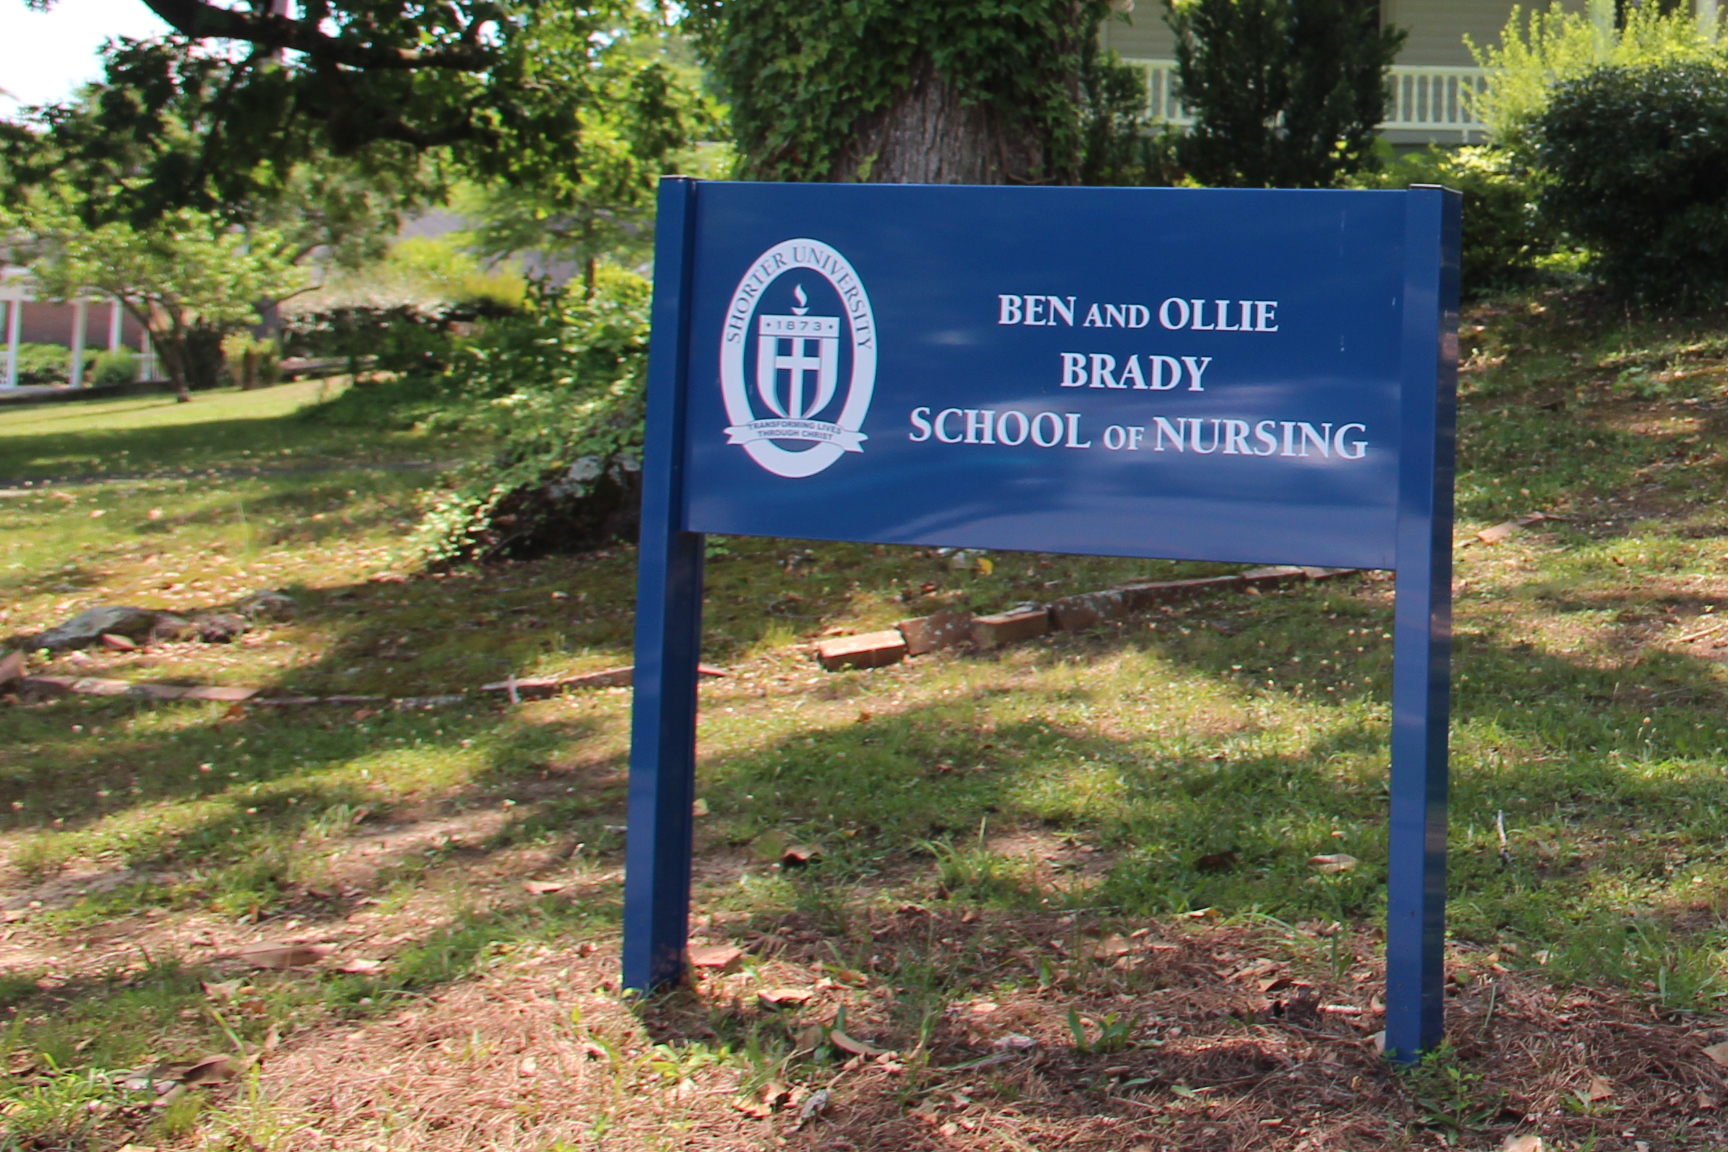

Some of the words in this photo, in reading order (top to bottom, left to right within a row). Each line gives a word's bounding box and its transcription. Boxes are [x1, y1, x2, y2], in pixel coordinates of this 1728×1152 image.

[727, 252, 787, 344] SHORTER
[793, 246, 873, 349] UNIVERSITY
[998, 294, 1075, 326] BEN
[1083, 304, 1149, 328] AND
[1158, 297, 1278, 331] OLLIE
[776, 320, 822, 332] 1873
[1060, 352, 1212, 392] BRADY
[748, 421, 815, 431] TRANSFORMING
[817, 423, 843, 435] LIVES
[757, 429, 800, 438] THROUGH
[801, 430, 834, 440] CHRIST
[909, 407, 1091, 448] SCHOOL
[1103, 425, 1145, 450] OF
[1152, 416, 1368, 459] NURSING
